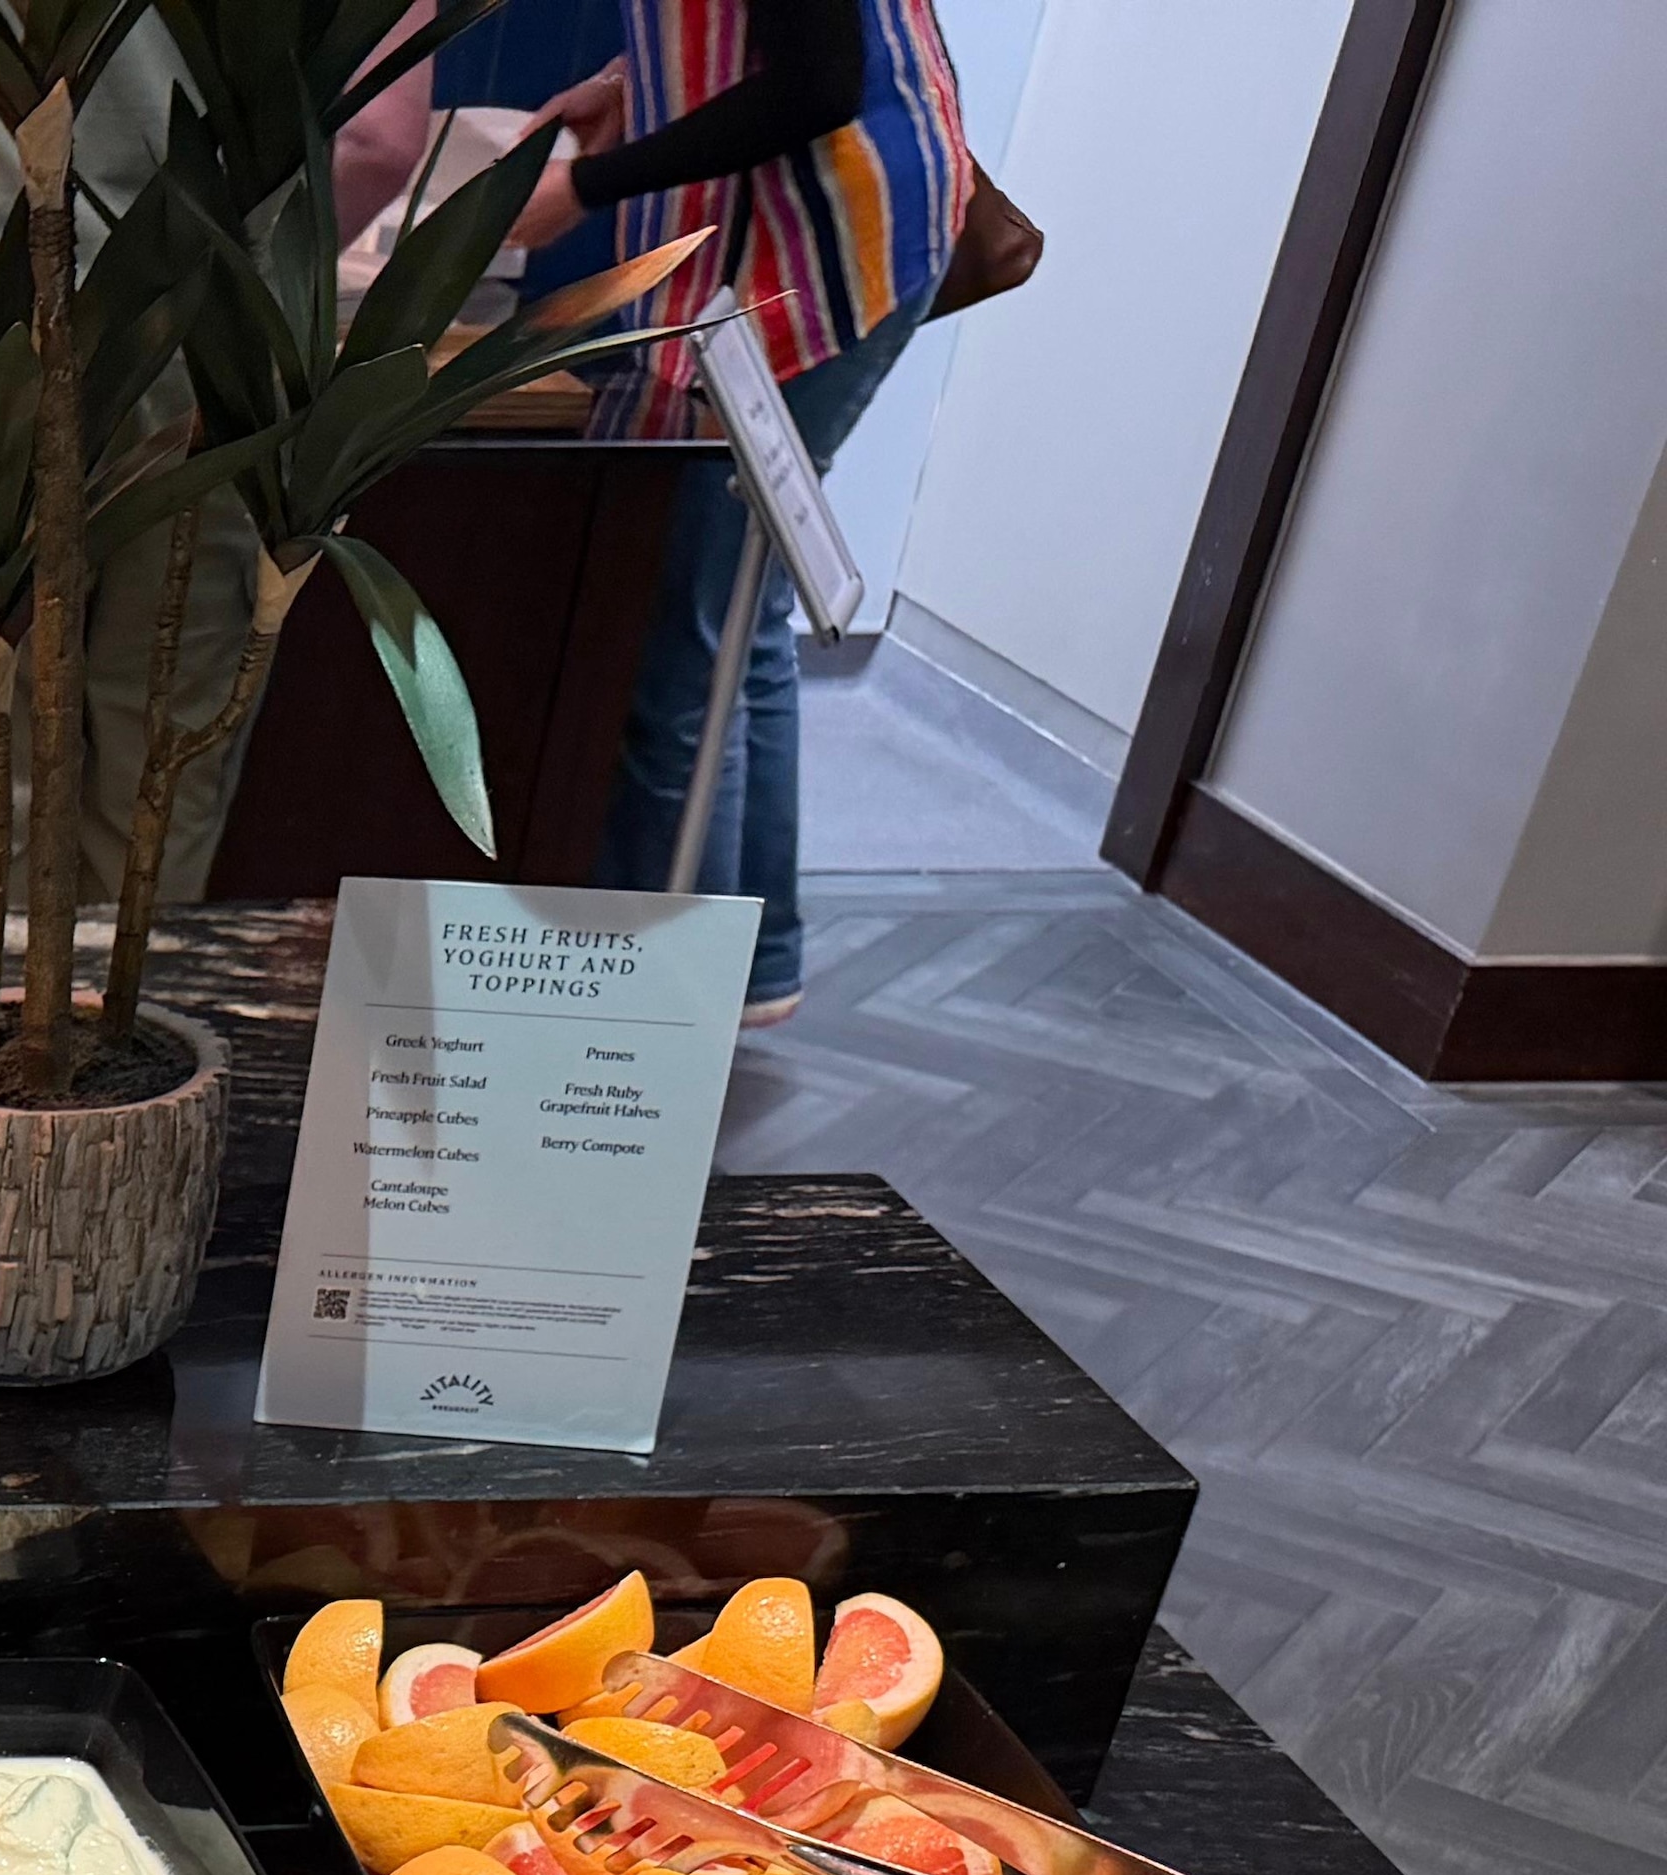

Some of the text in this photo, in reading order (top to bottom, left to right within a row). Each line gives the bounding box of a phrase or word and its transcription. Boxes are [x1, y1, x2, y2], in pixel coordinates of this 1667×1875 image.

[443, 924, 642, 952] FRESH FRUITS,
[444, 948, 635, 975] YOGHURT AND
[469, 974, 601, 998] TOPPINGS
[386, 1034, 484, 1053] Greek Yoghurt
[586, 1047, 635, 1062] Prunes
[372, 1071, 487, 1089] Fresh Fruit Salad
[565, 1083, 643, 1102] Fresh Ruby
[366, 1106, 478, 1126] Pineapple Cubes
[540, 1100, 660, 1119] Grapefruit Halves
[353, 1142, 479, 1162] Watermelon Cubes
[541, 1136, 645, 1156] Berry Compote
[371, 1180, 448, 1197] Cantaloupe
[363, 1196, 450, 1213] Melon Cubes
[420, 1374, 494, 1405] VITALITY
